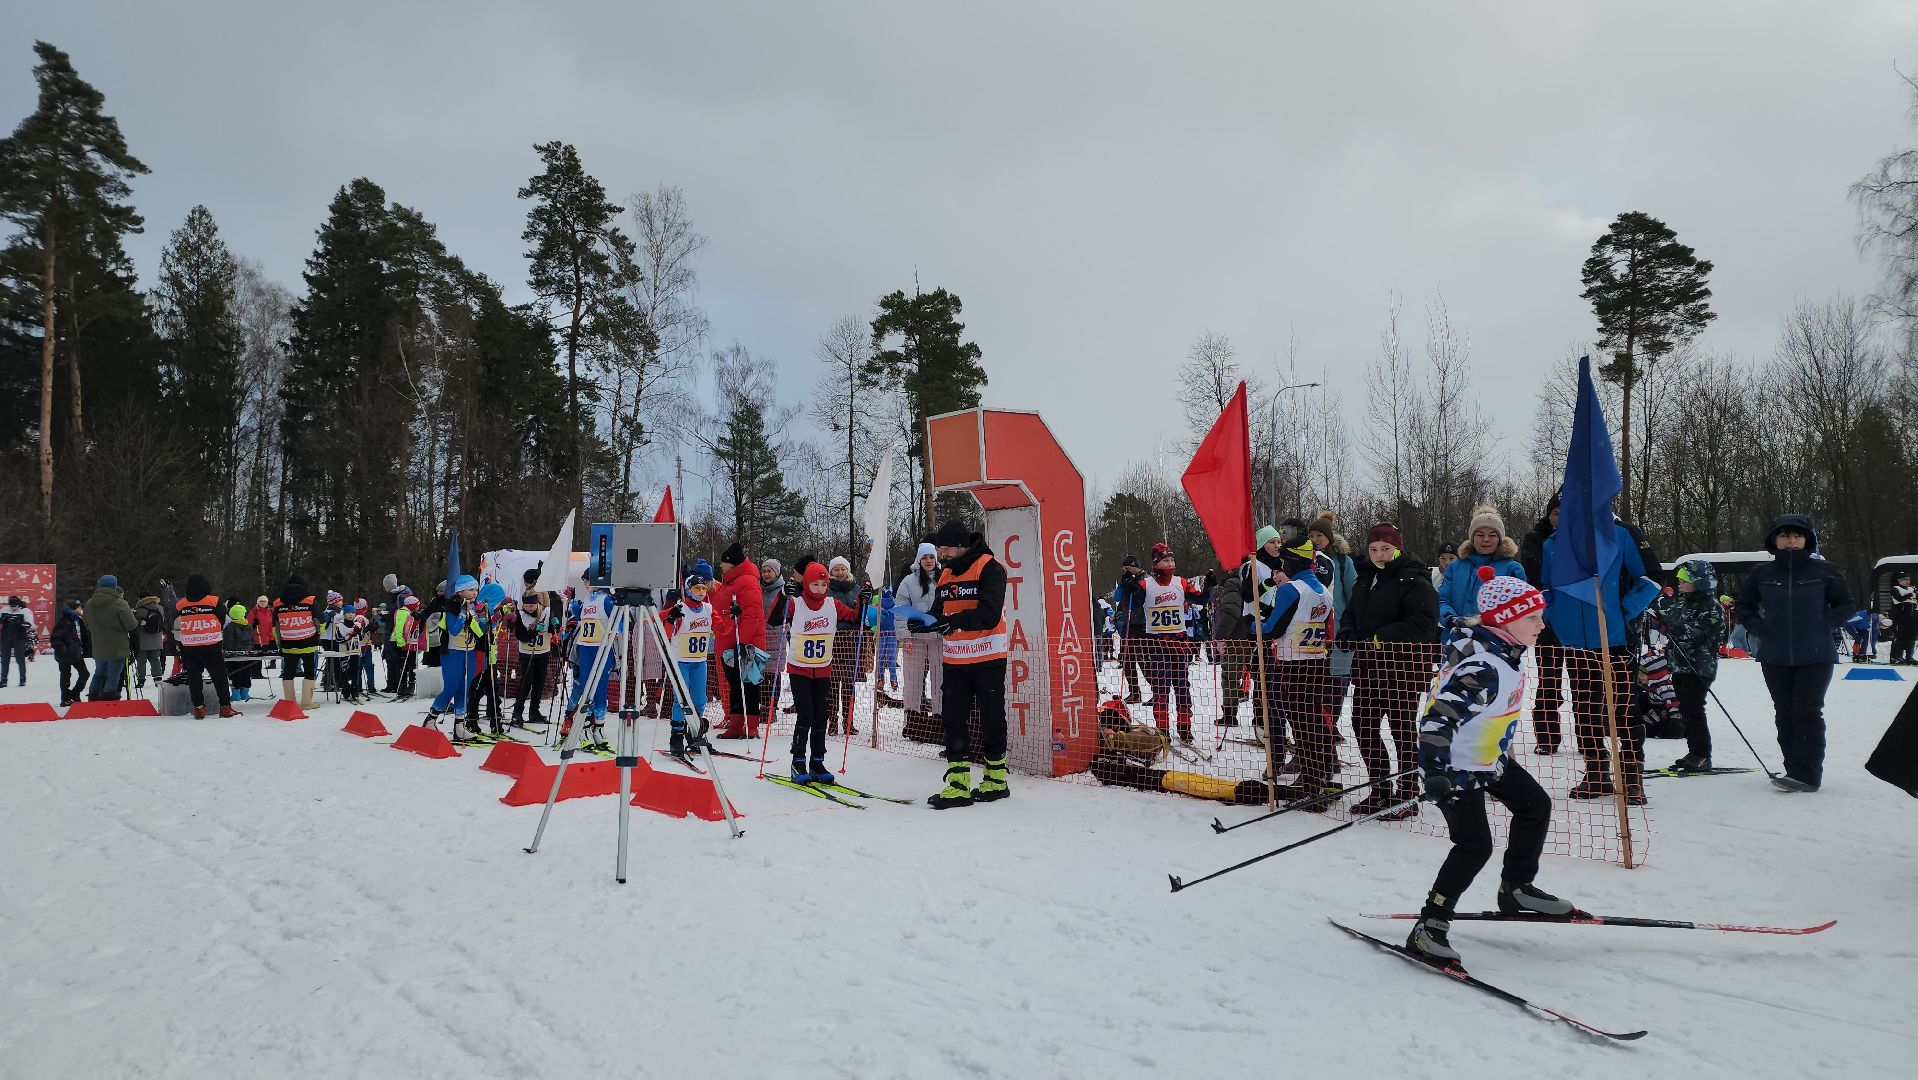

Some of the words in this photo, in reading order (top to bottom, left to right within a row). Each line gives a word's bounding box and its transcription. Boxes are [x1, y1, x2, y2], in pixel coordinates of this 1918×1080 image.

[958, 586, 978, 597] Sport
[180, 619, 218, 632] СУДЬЯ
[279, 615, 314, 627] СУДЬЯ
[1151, 609, 1182, 627] 265
[582, 622, 596, 638] 87
[1004, 534, 1030, 736] СТАРТ
[1053, 529, 1083, 738] СТАРТ
[688, 635, 707, 654] 86
[803, 639, 826, 659] 85
